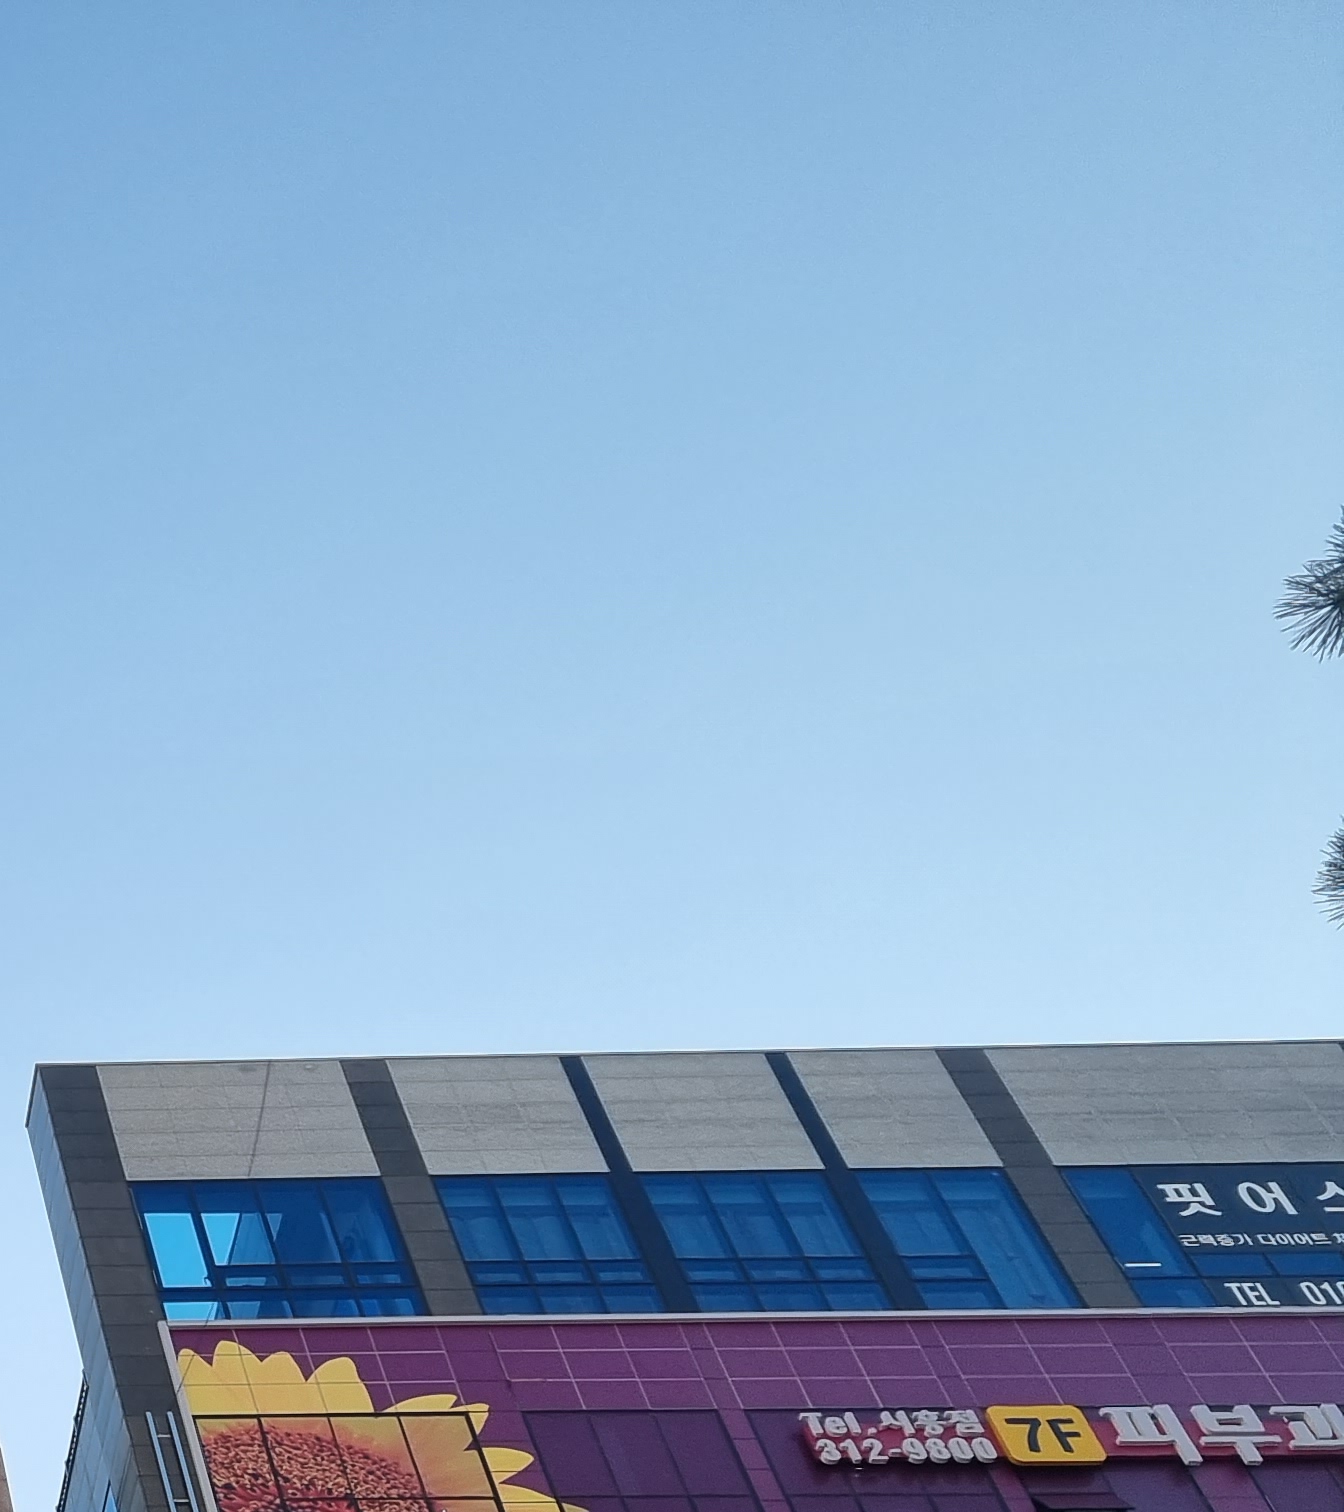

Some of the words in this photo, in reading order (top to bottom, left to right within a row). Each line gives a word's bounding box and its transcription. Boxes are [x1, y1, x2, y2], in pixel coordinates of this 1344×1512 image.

[1255, 1232, 1332, 1246] 다이어트
[1223, 1282, 1281, 1306] TEL
[1004, 1416, 1083, 1454] 7F
[1099, 1403, 1344, 1467] 피부과
[815, 1437, 998, 1465] 312-9800
